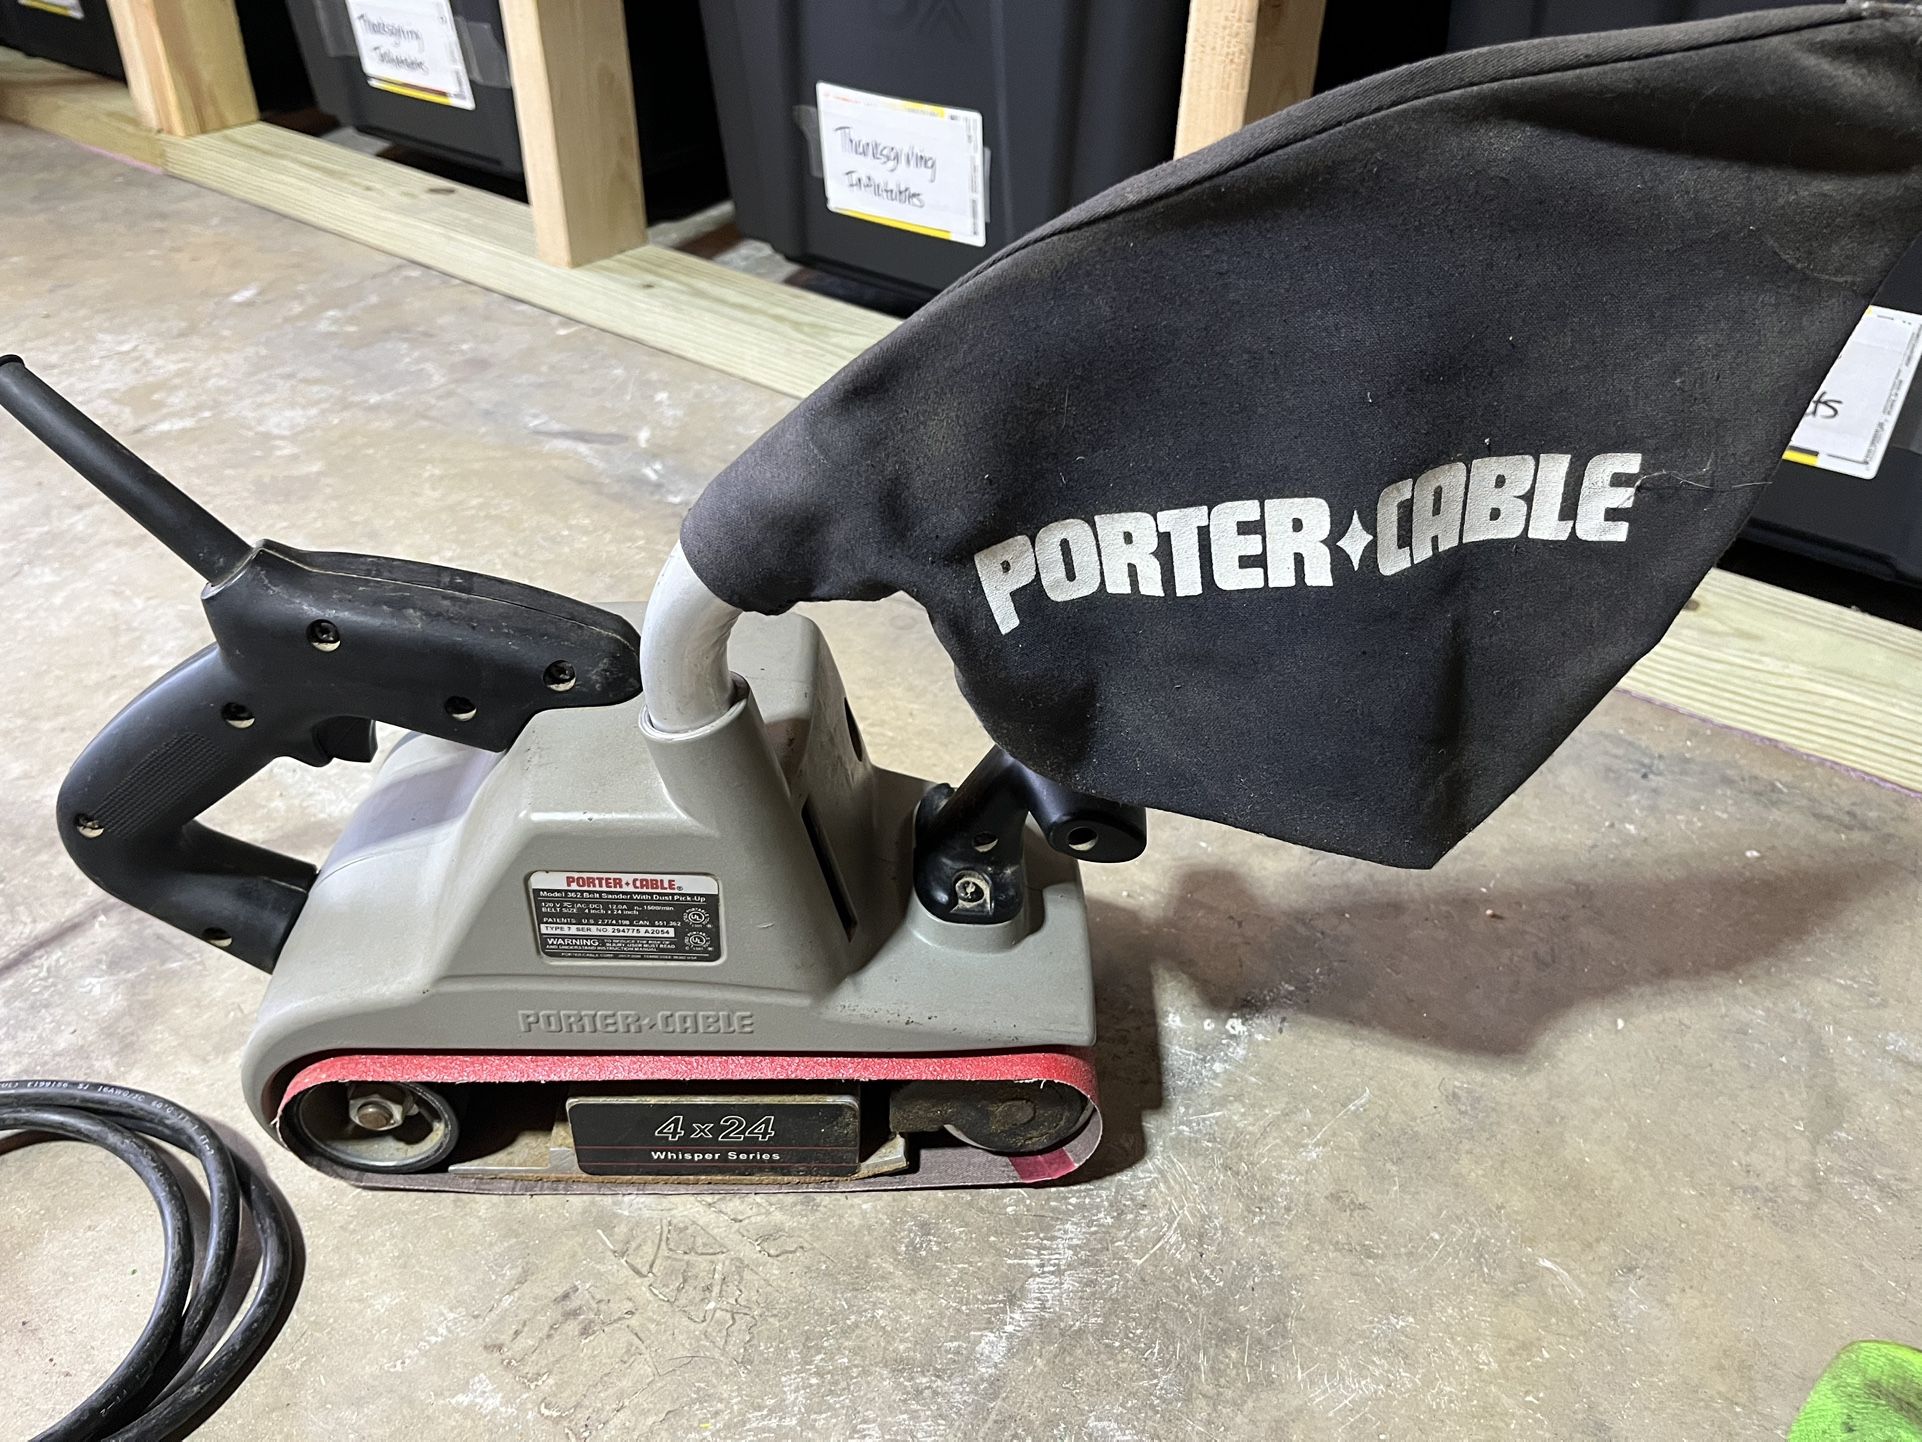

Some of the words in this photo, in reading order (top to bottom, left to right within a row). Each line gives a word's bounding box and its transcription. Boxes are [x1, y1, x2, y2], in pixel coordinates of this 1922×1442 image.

[834, 126, 937, 183] Thanksgiving
[974, 497, 1333, 635] PORTER
[1376, 453, 1642, 576] CABLE
[566, 876, 623, 888] PORTER
[674, 895, 706, 903] Pick-Up
[517, 1010, 642, 1033] PORTER
[657, 1011, 754, 1034] CABLE
[655, 1116, 684, 1141] 4
[690, 1123, 713, 1138] x
[718, 1116, 776, 1141] 24
[651, 1150, 721, 1162] Whisper
[727, 1150, 781, 1161] Series
